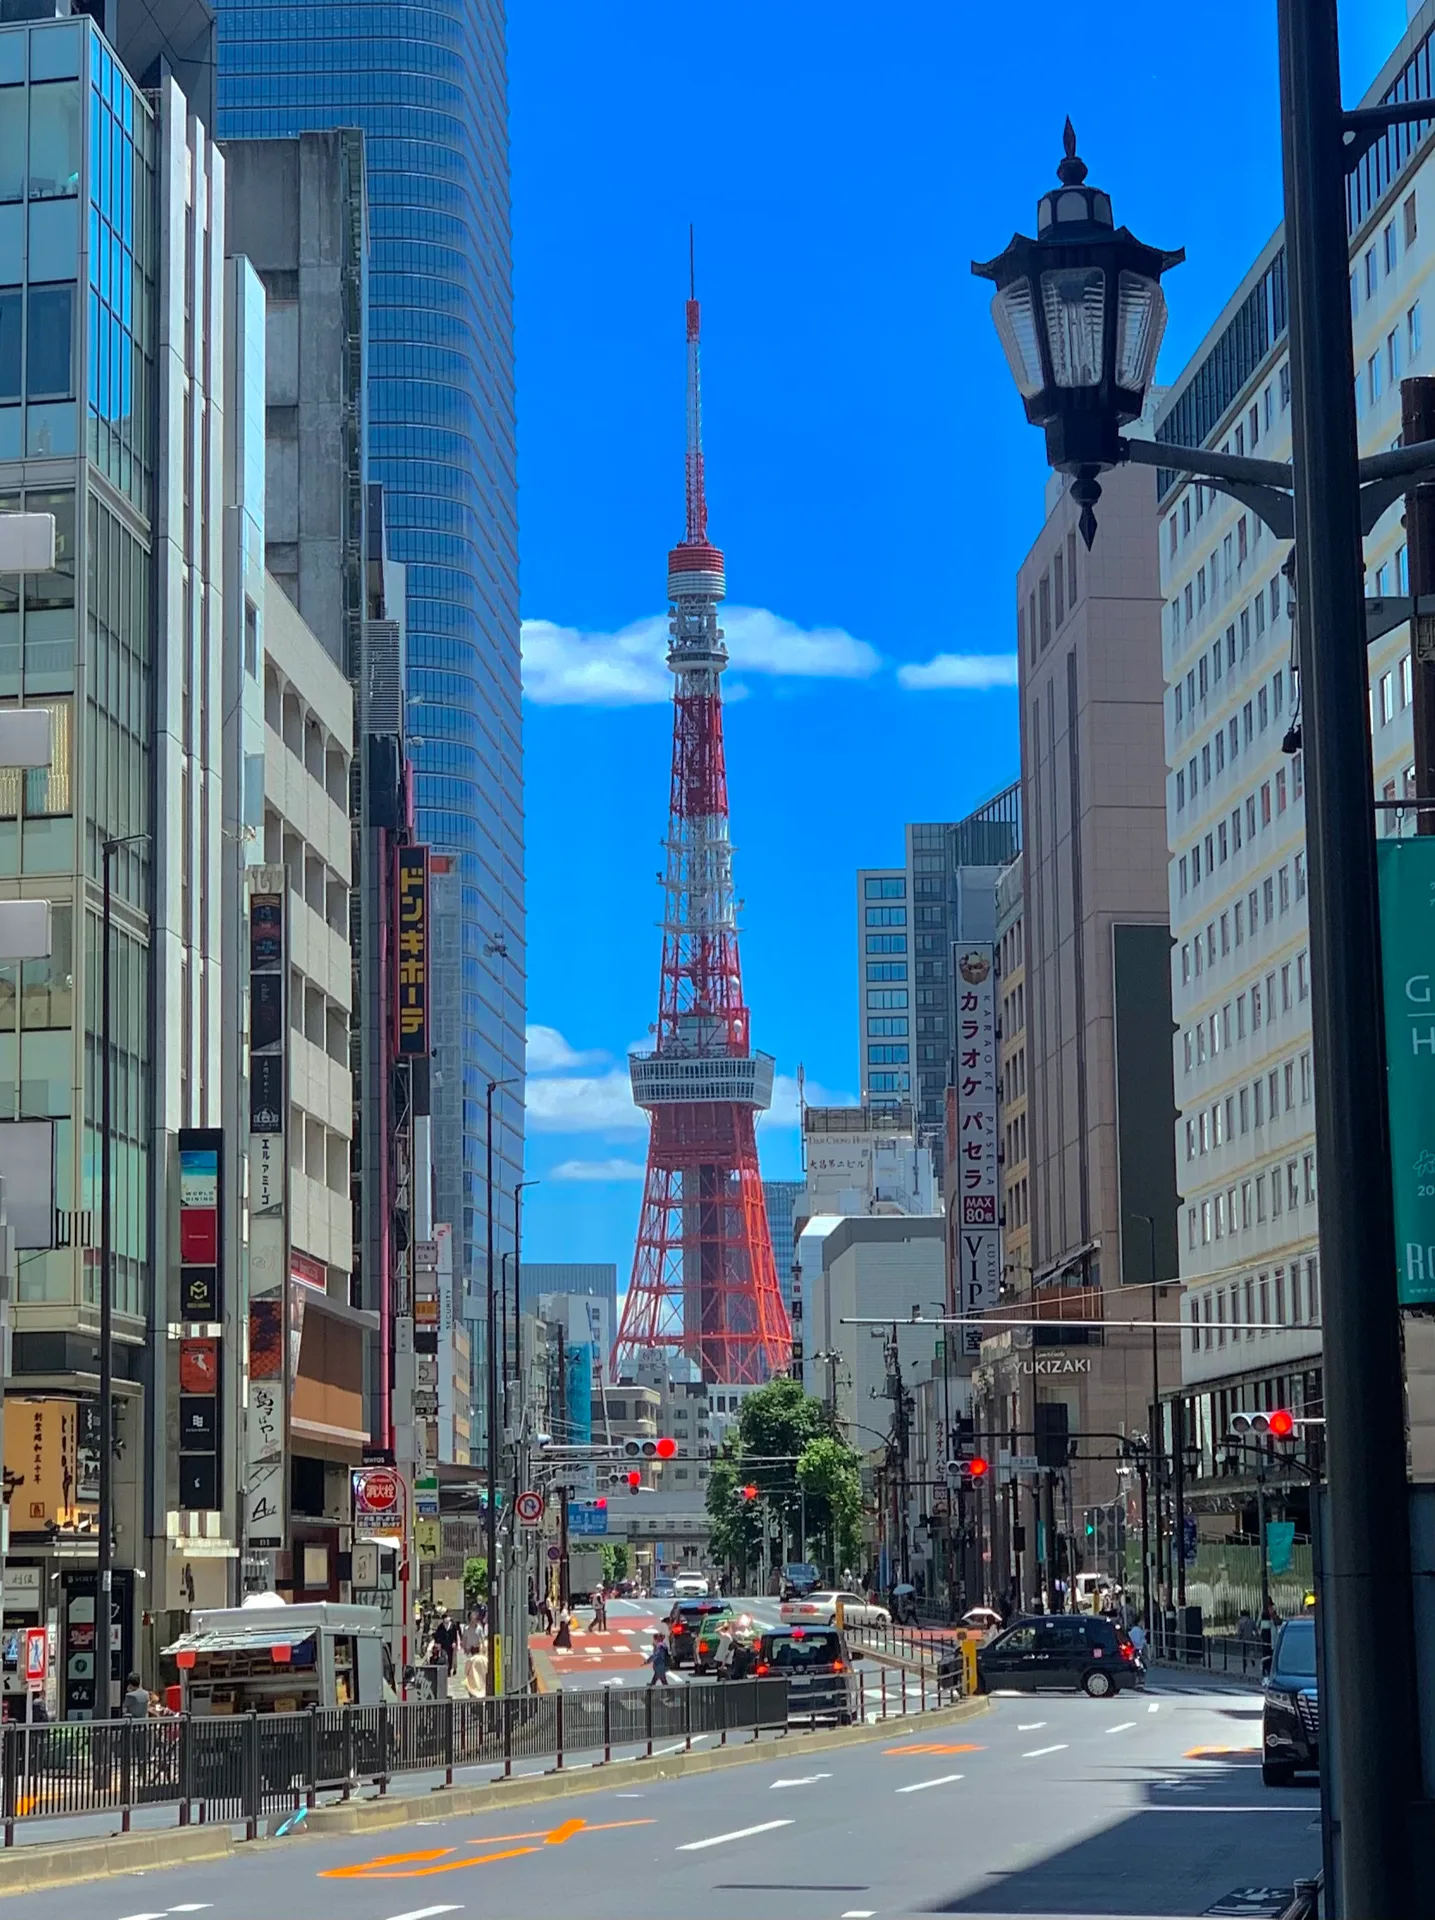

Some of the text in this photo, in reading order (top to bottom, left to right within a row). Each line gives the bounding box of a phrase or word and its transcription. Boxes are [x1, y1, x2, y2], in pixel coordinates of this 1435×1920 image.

[400, 868, 424, 1033] ドン・キホーテ
[960, 991, 982, 1097] カラオケ
[983, 995, 993, 1092] KARAOKE
[962, 1111, 983, 1189] パセラ
[985, 1116, 995, 1186] PASELA
[965, 1197, 992, 1208] MAX
[986, 1243, 996, 1295] LUXURY
[1013, 1359, 1091, 1374] YUKIZAKI
[366, 1484, 395, 1499] 消火栓
